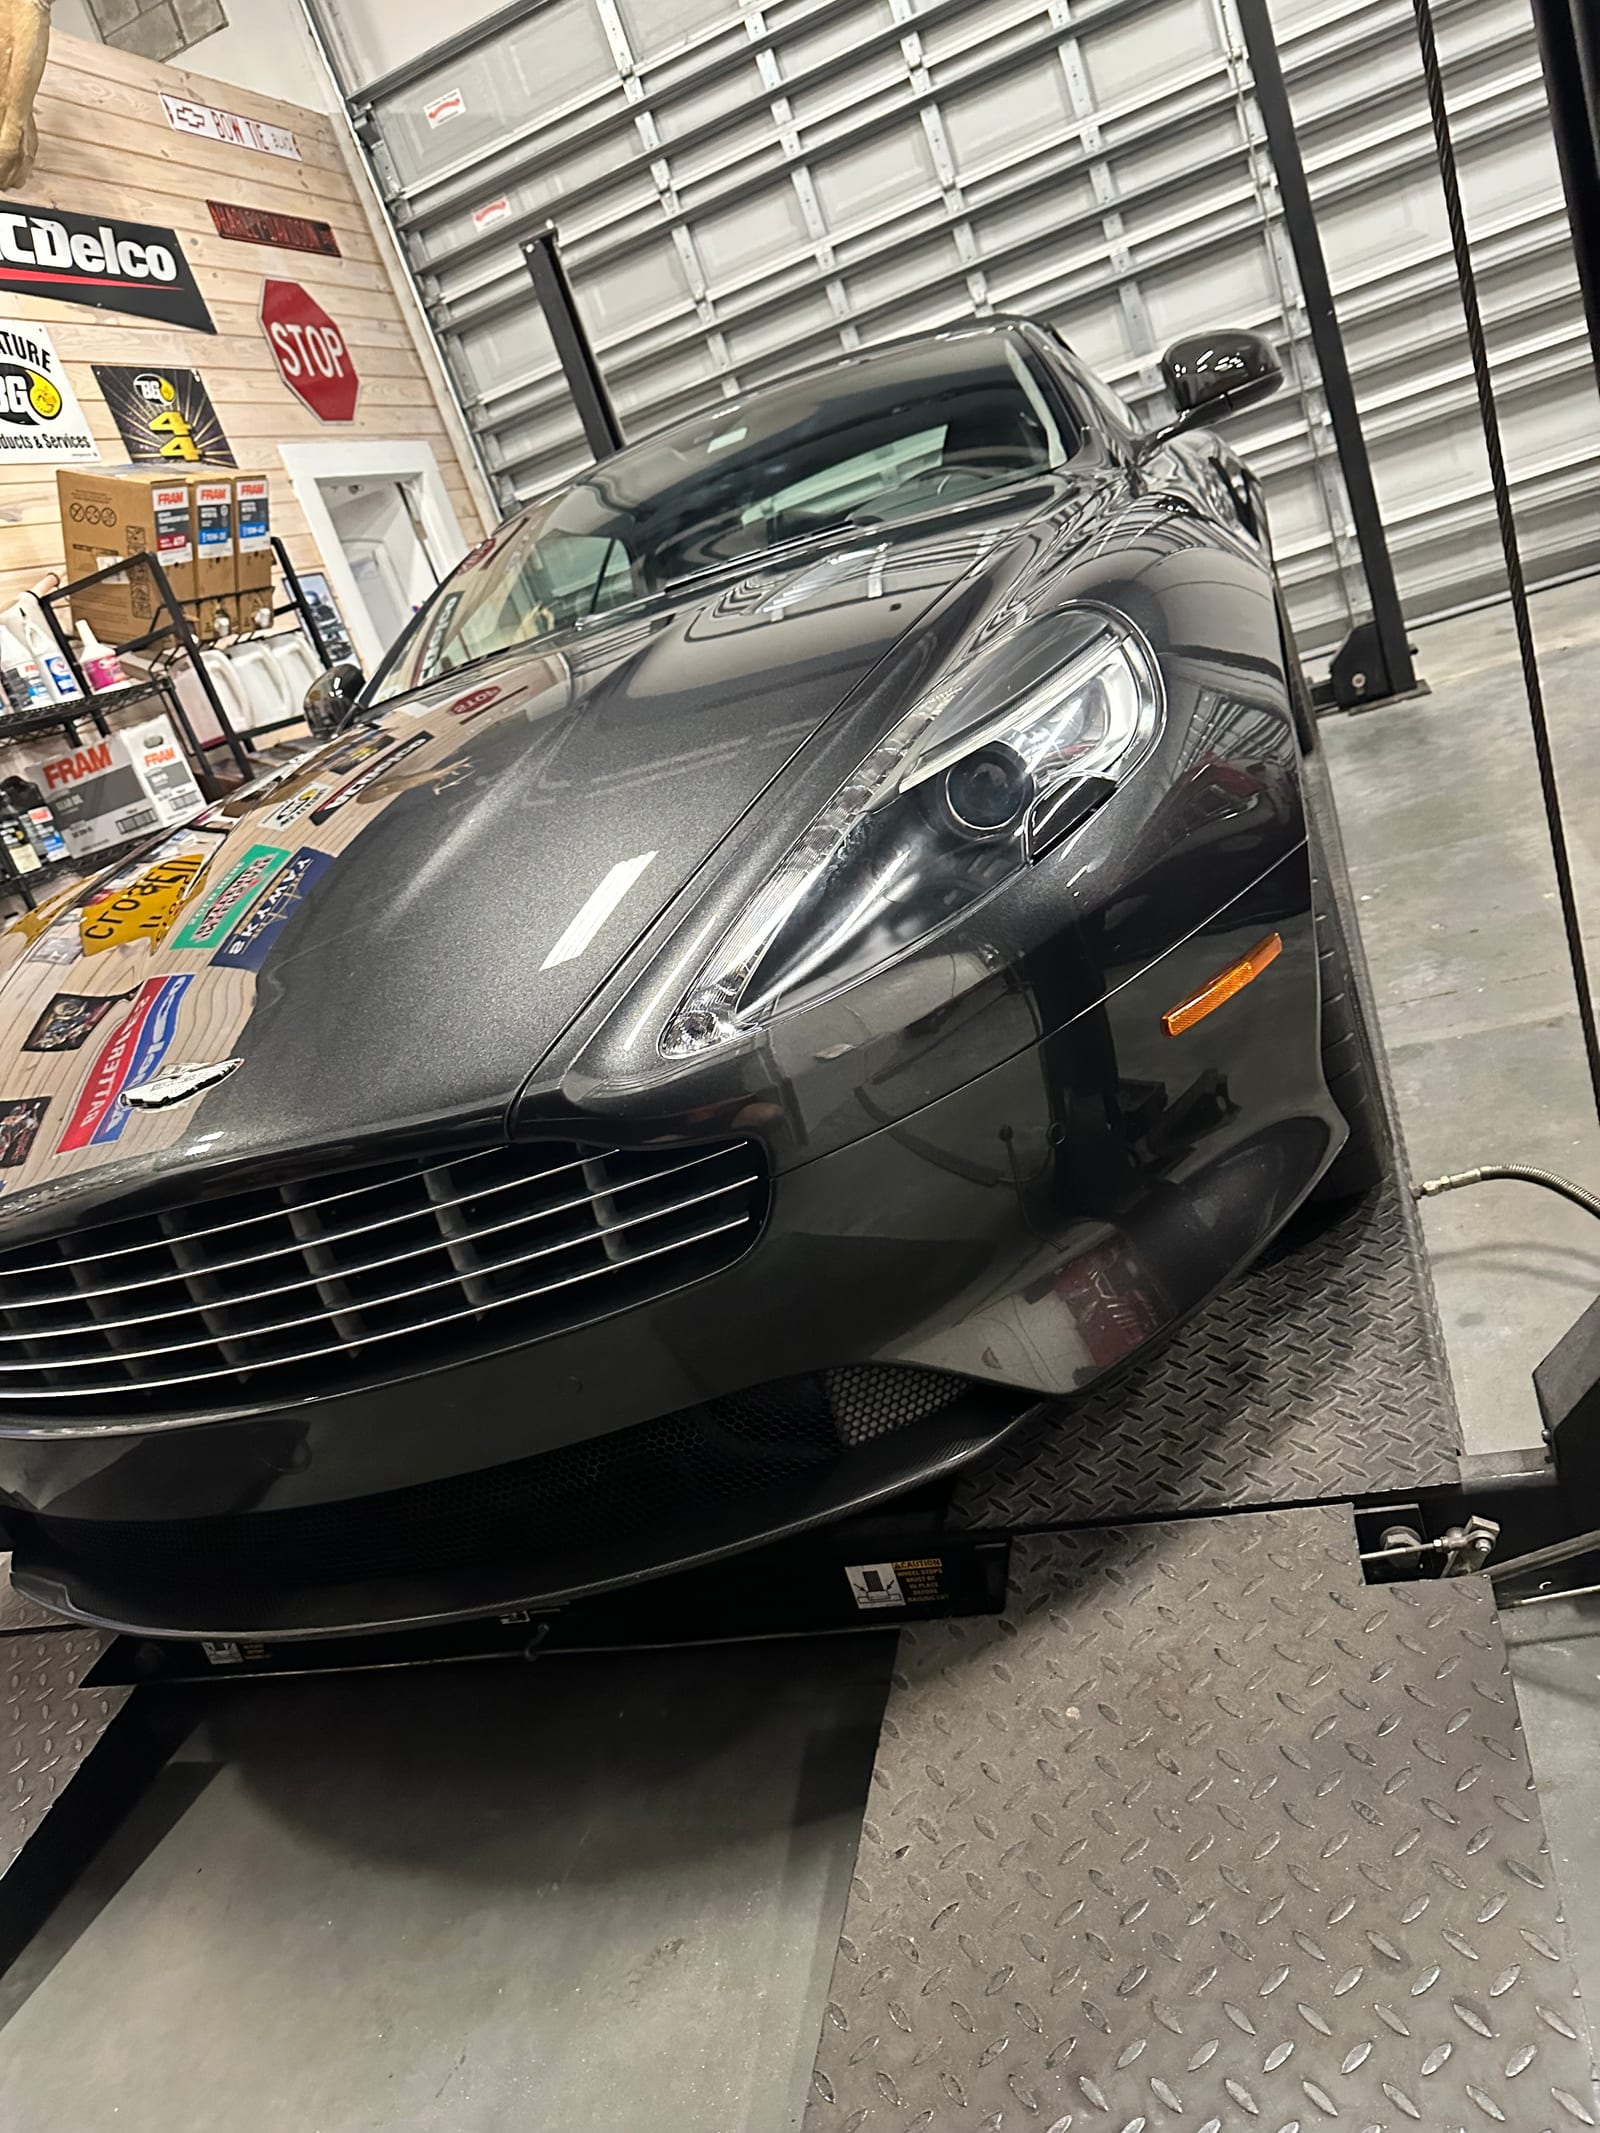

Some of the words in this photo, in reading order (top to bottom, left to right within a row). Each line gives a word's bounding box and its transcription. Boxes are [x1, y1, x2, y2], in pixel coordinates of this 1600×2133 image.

[210, 111, 245, 144] BOW
[245, 121, 270, 151] TIE
[0, 212, 177, 281] CDelco
[271, 321, 344, 378] STOP
[0, 433, 33, 449] ducts
[42, 433, 91, 449] Services
[157, 491, 184, 506] FRAM
[201, 488, 227, 501] FRAM
[241, 484, 265, 496] FRAM
[43, 742, 113, 789] FRAM
[144, 747, 176, 767] FRAM
[901, 1559, 941, 1569] CAUTION
